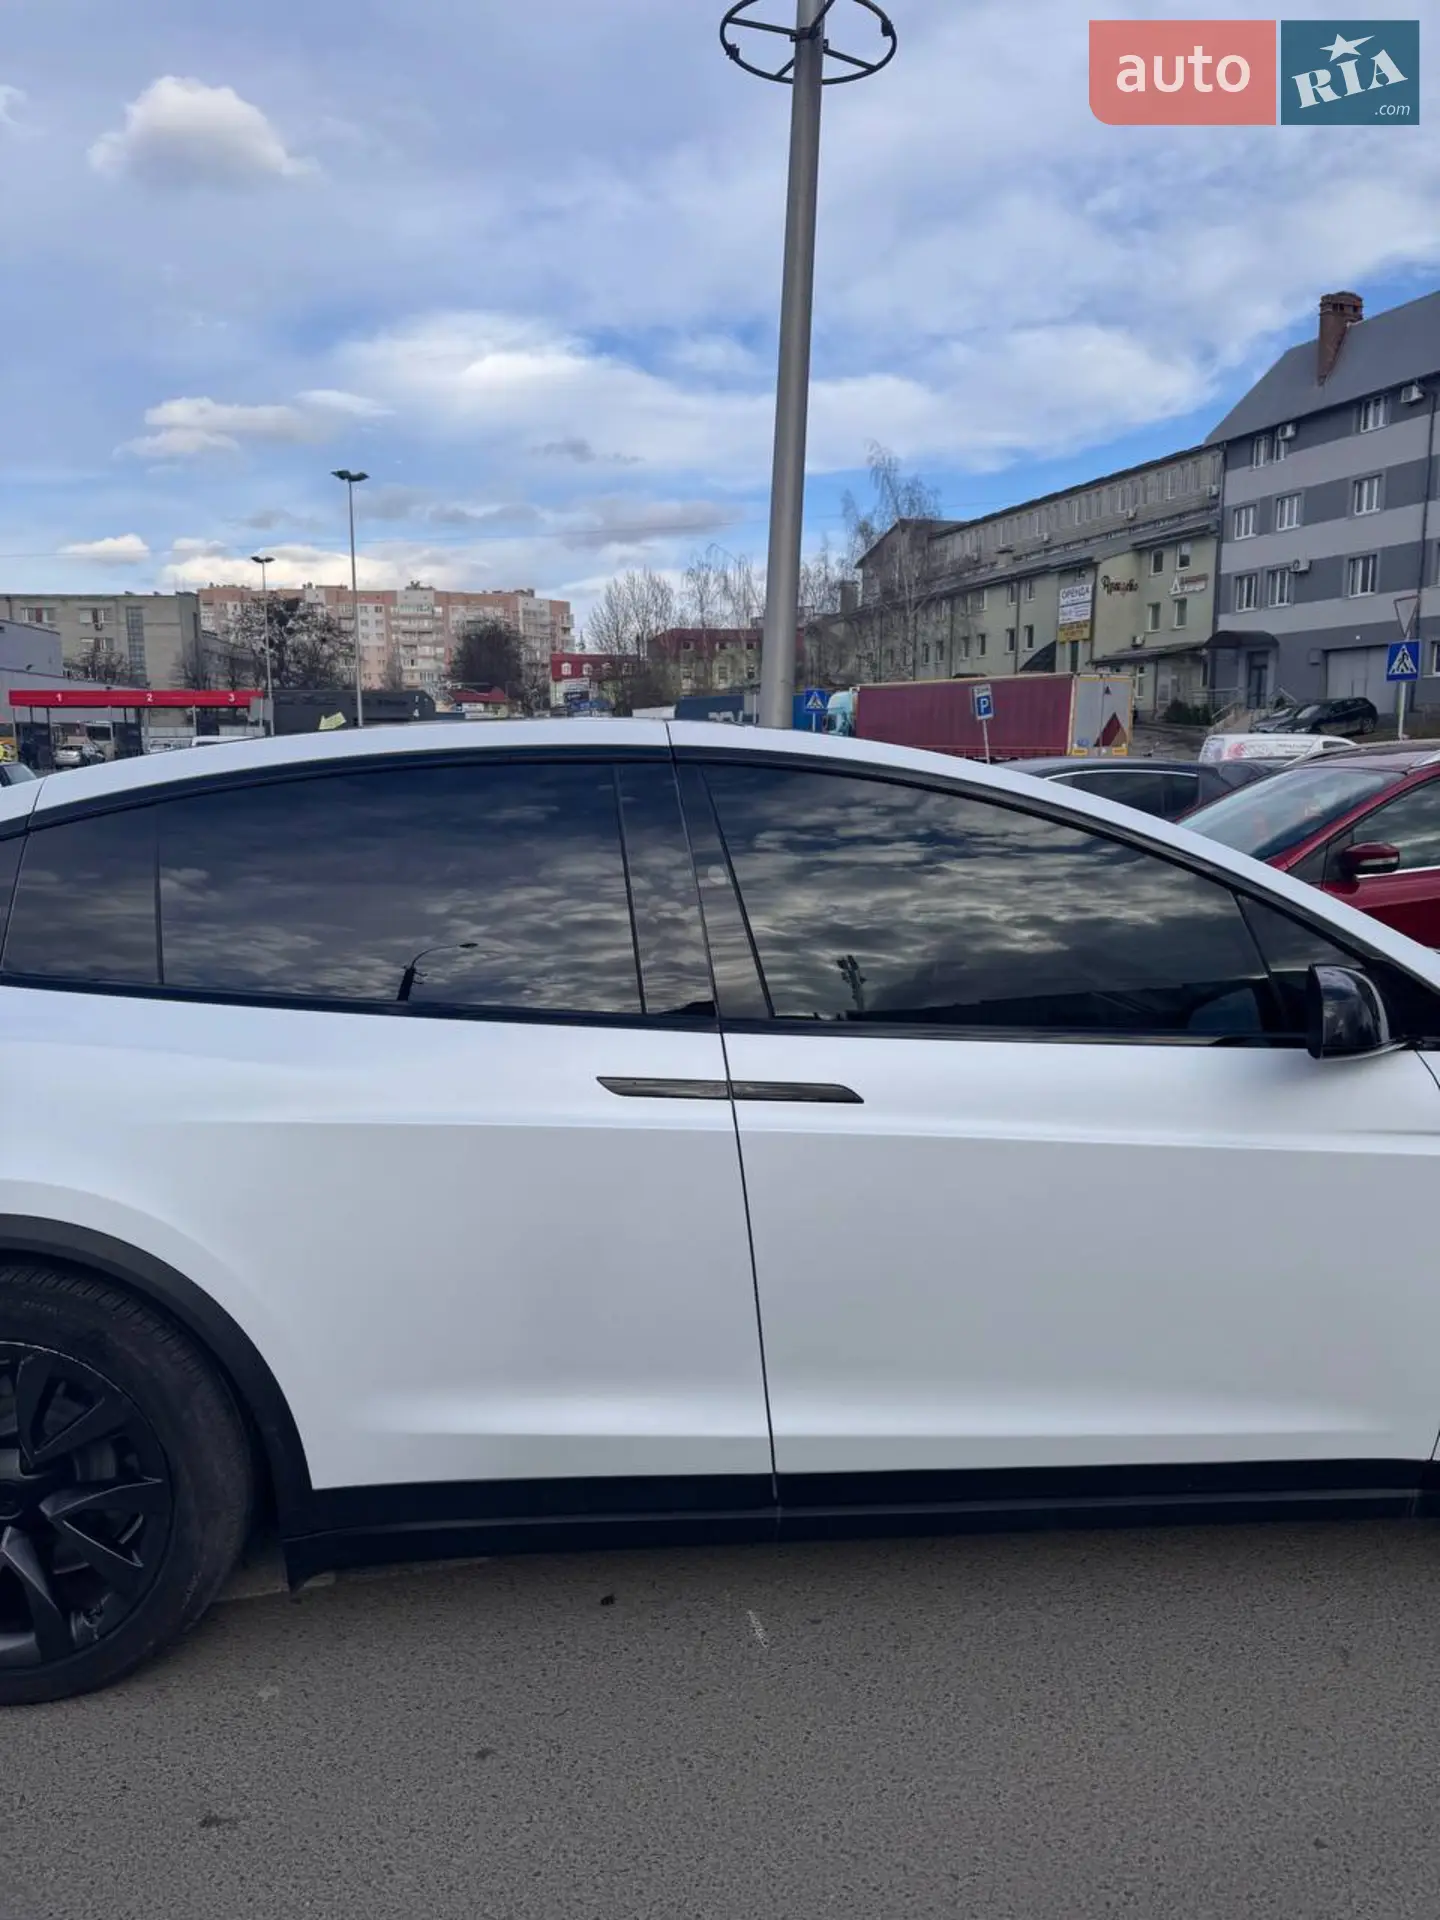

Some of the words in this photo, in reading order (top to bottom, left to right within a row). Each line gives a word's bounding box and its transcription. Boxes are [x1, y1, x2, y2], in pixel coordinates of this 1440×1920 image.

[56, 693, 62, 702] 1
[146, 693, 153, 702] 2
[228, 693, 235, 702] 3
[980, 698, 989, 713] P
